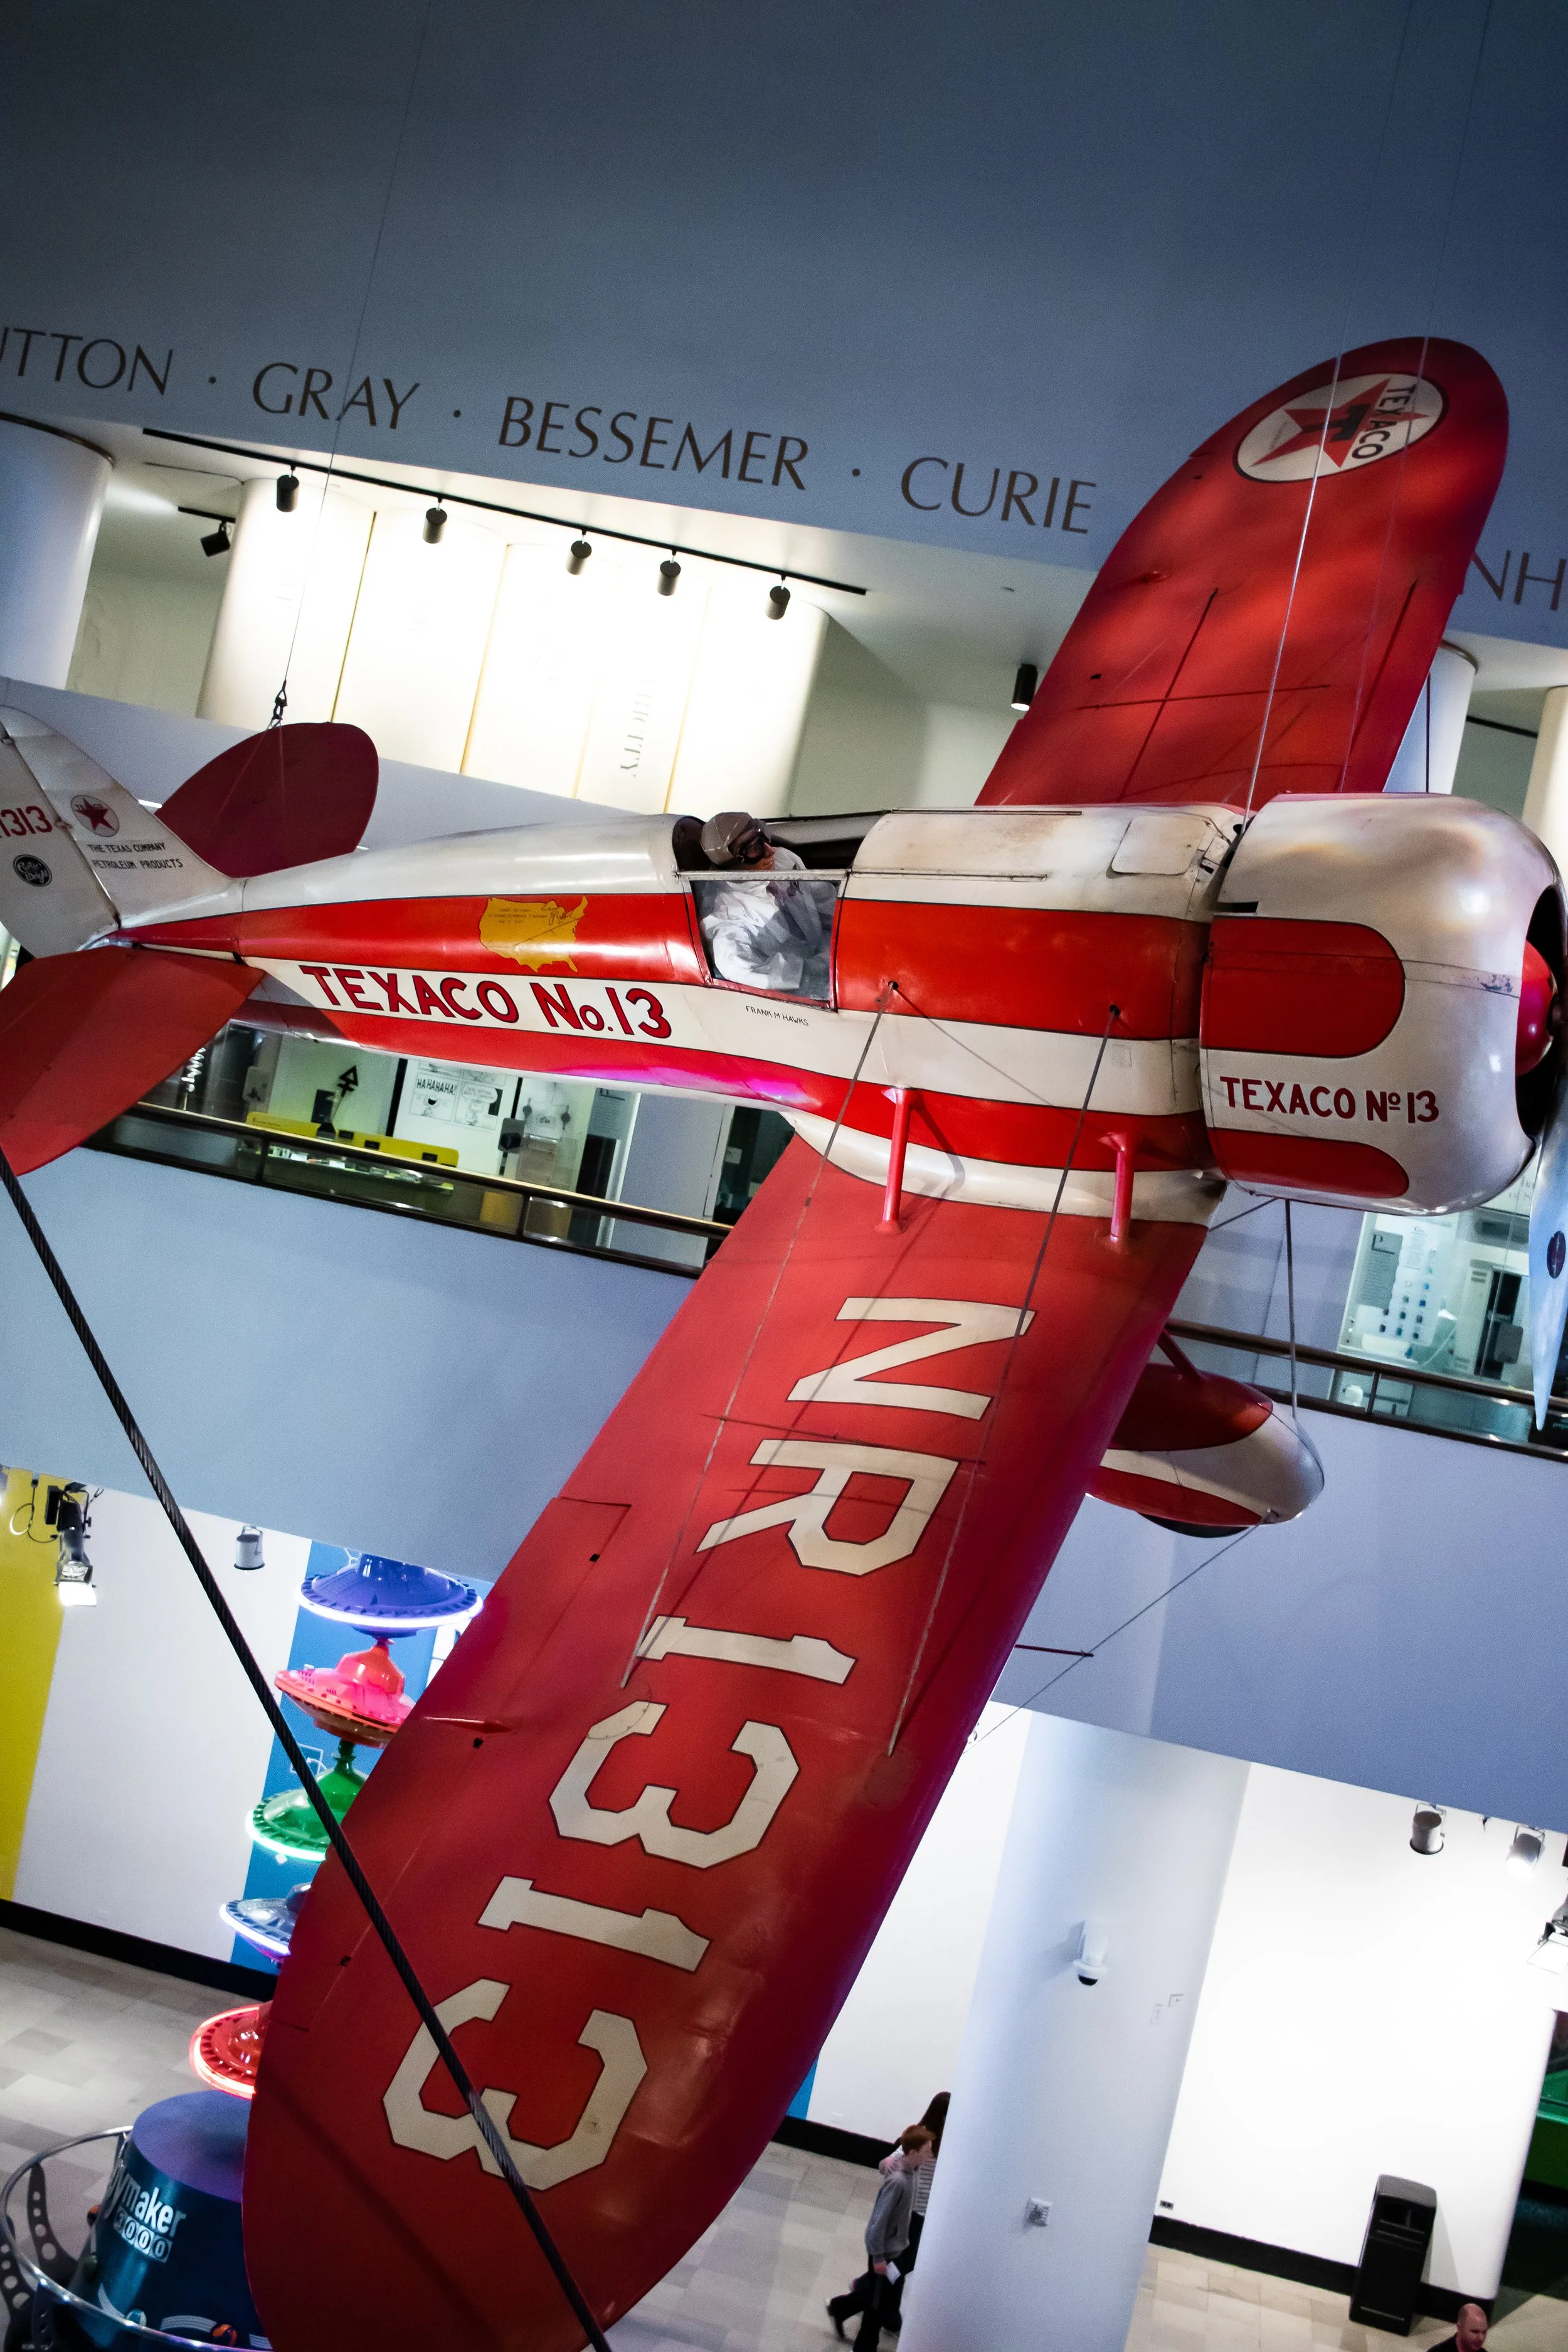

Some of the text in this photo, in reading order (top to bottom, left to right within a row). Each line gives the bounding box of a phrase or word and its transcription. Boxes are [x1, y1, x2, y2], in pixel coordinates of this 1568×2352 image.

[1351, 383, 1416, 459] TEXACO
[252, 363, 420, 430] GRAY
[498, 396, 809, 491] BESSEMER
[900, 456, 1098, 535] CURIE
[87, 842, 166, 853] THE TEXAS COMPANY
[92, 858, 184, 869] PETROLEUM PRODUCTS
[299, 965, 520, 1024] TEXACO
[745, 1005, 773, 1018] FRANK
[781, 1014, 809, 1026] HAWKS
[1219, 1076, 1356, 1120] TEXACO
